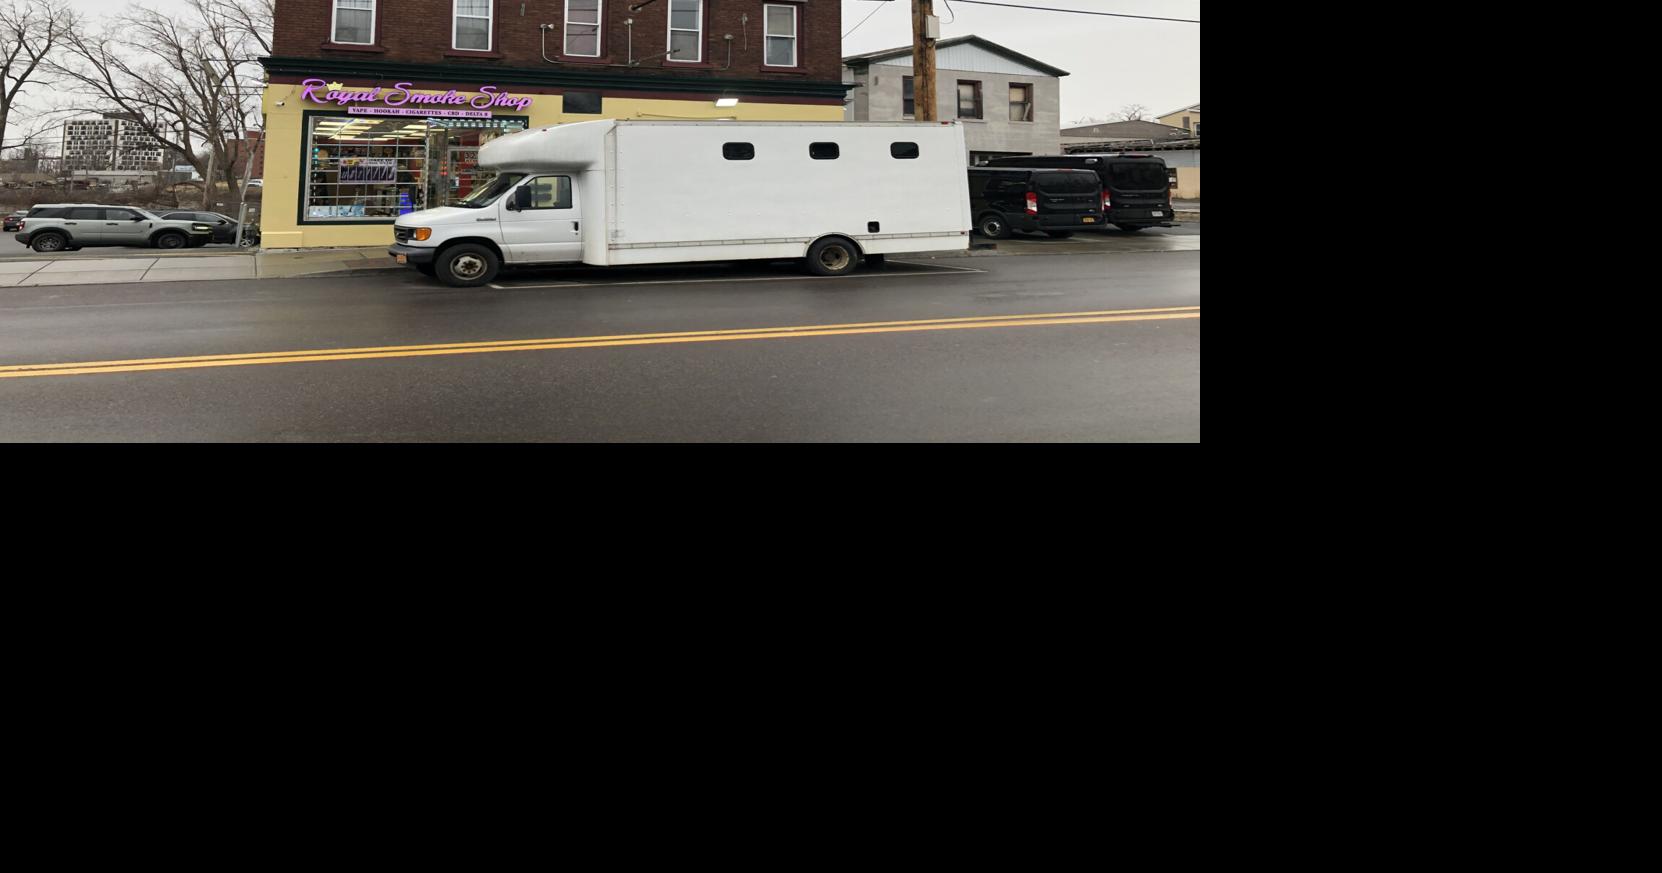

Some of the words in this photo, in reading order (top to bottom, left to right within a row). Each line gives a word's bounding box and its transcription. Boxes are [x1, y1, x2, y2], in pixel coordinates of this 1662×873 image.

[301, 78, 381, 106] Royal
[384, 82, 466, 106] Smoke
[470, 86, 533, 111] Shop
